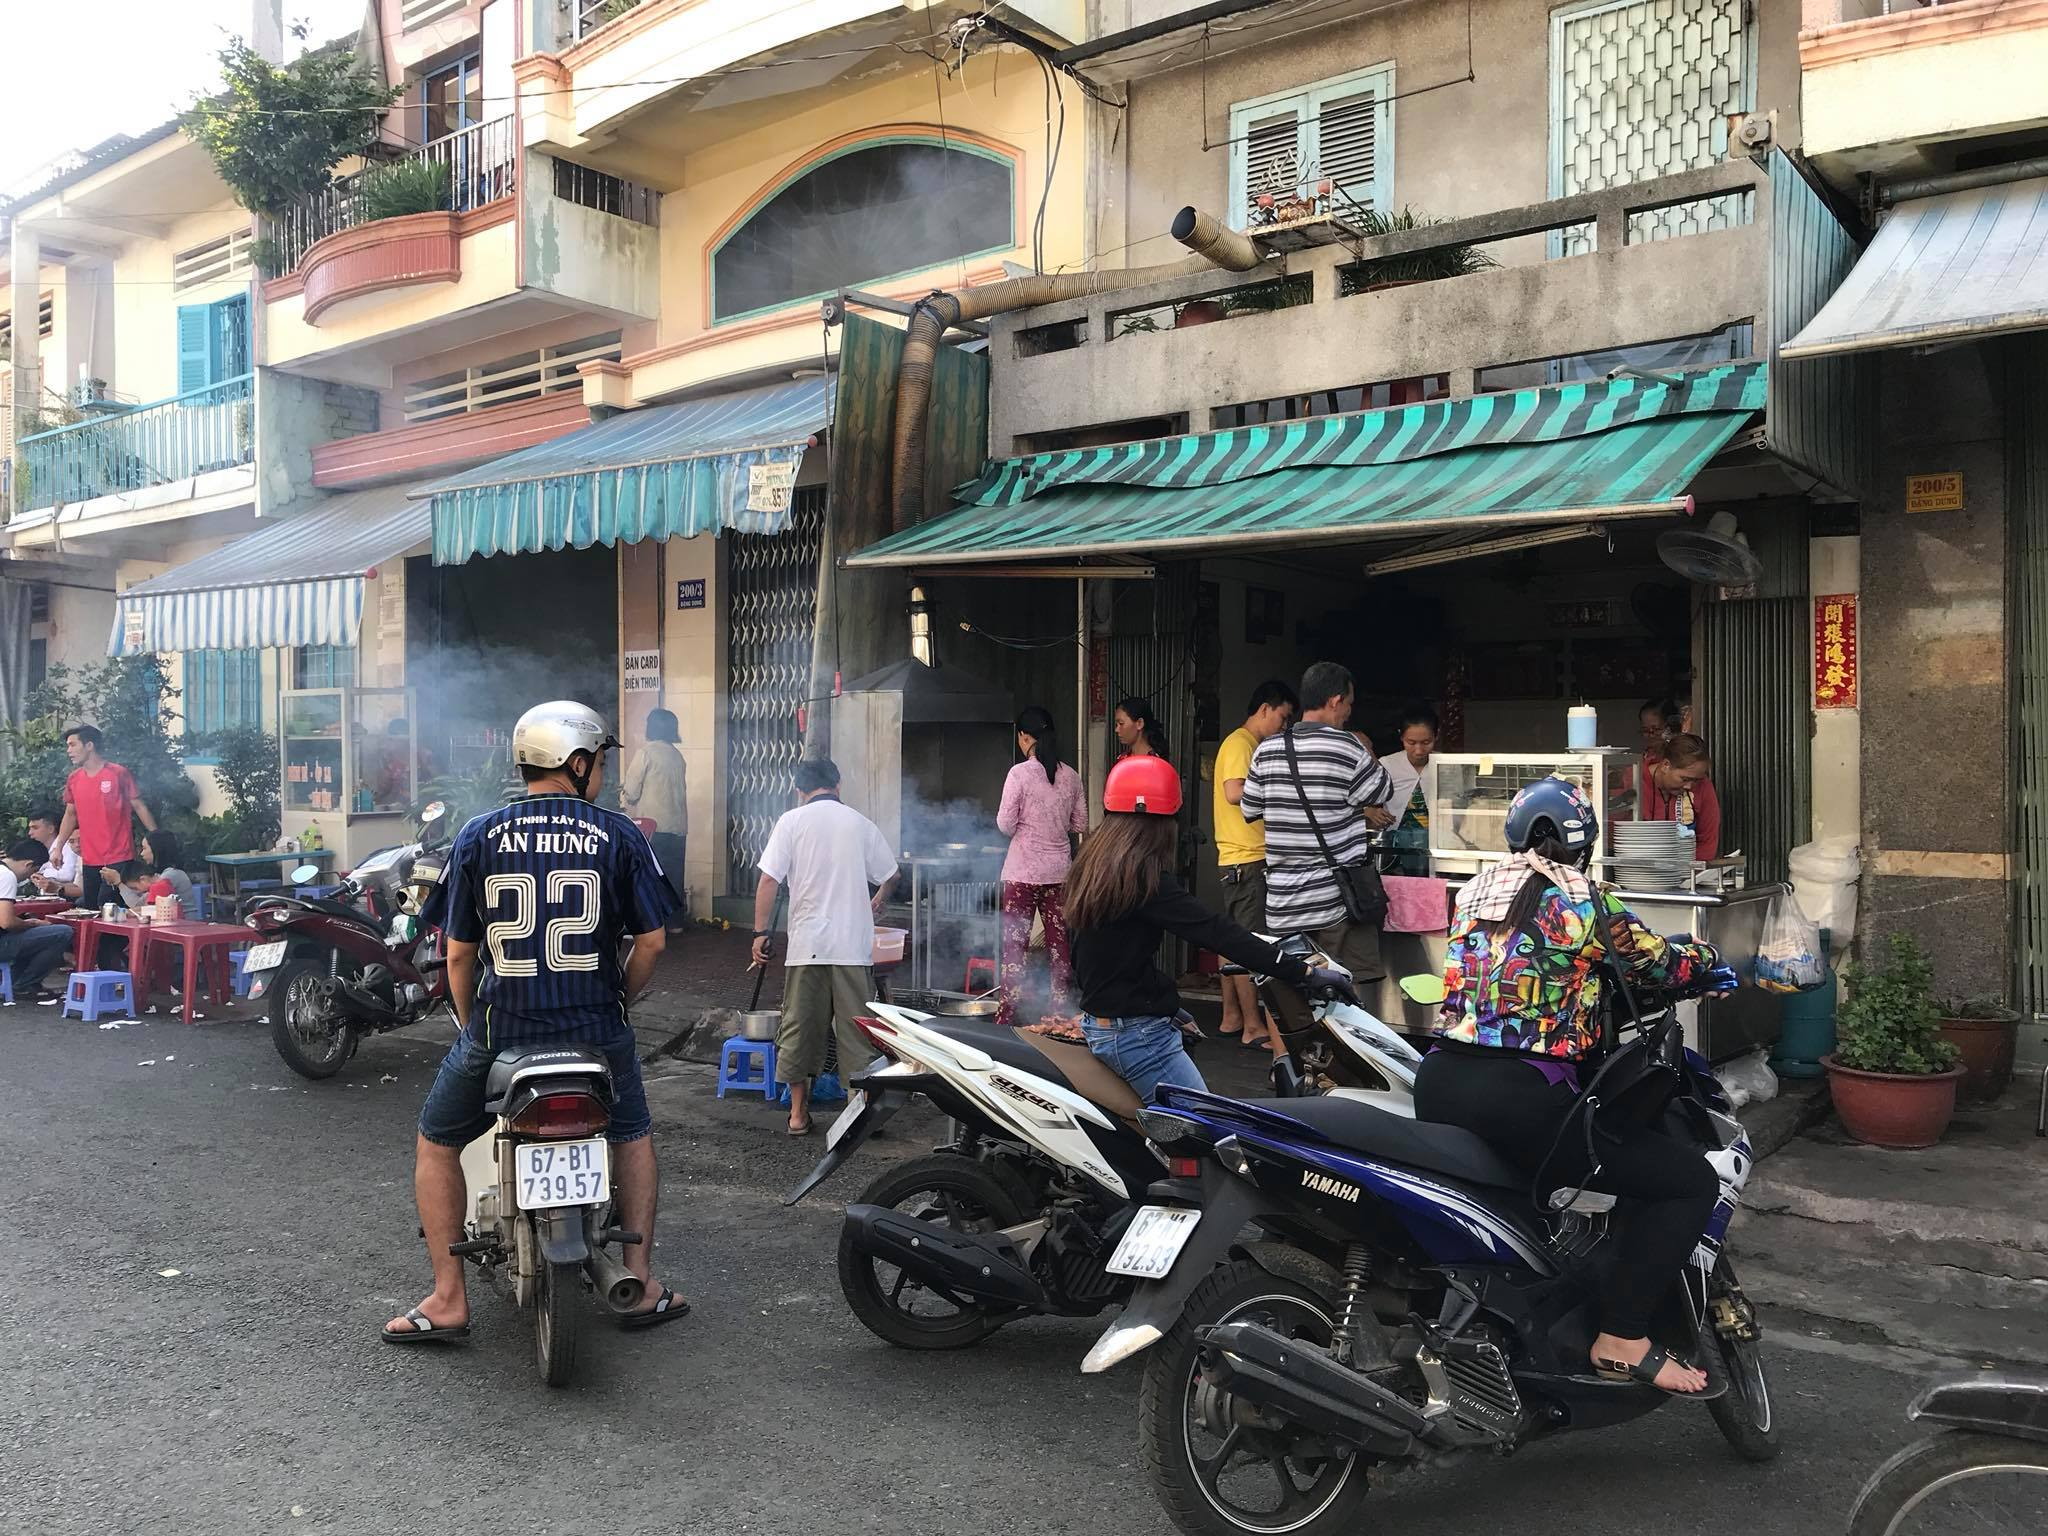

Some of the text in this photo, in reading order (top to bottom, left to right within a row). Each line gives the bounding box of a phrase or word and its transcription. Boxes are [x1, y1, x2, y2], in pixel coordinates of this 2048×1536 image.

[1912, 477, 1956, 495] 200/5
[679, 583, 703, 598] 200/3
[640, 655, 659, 670] CARD
[487, 820, 512, 839] CTY
[515, 815, 548, 826] TNHH
[551, 815, 576, 826] XÂY
[497, 832, 530, 853] AN
[484, 869, 601, 977] 22
[531, 1051, 582, 1062] HONDA
[531, 1144, 591, 1174] 67-B1
[523, 1172, 602, 1204] 739.57
[1301, 1170, 1361, 1203] YAMAHA
